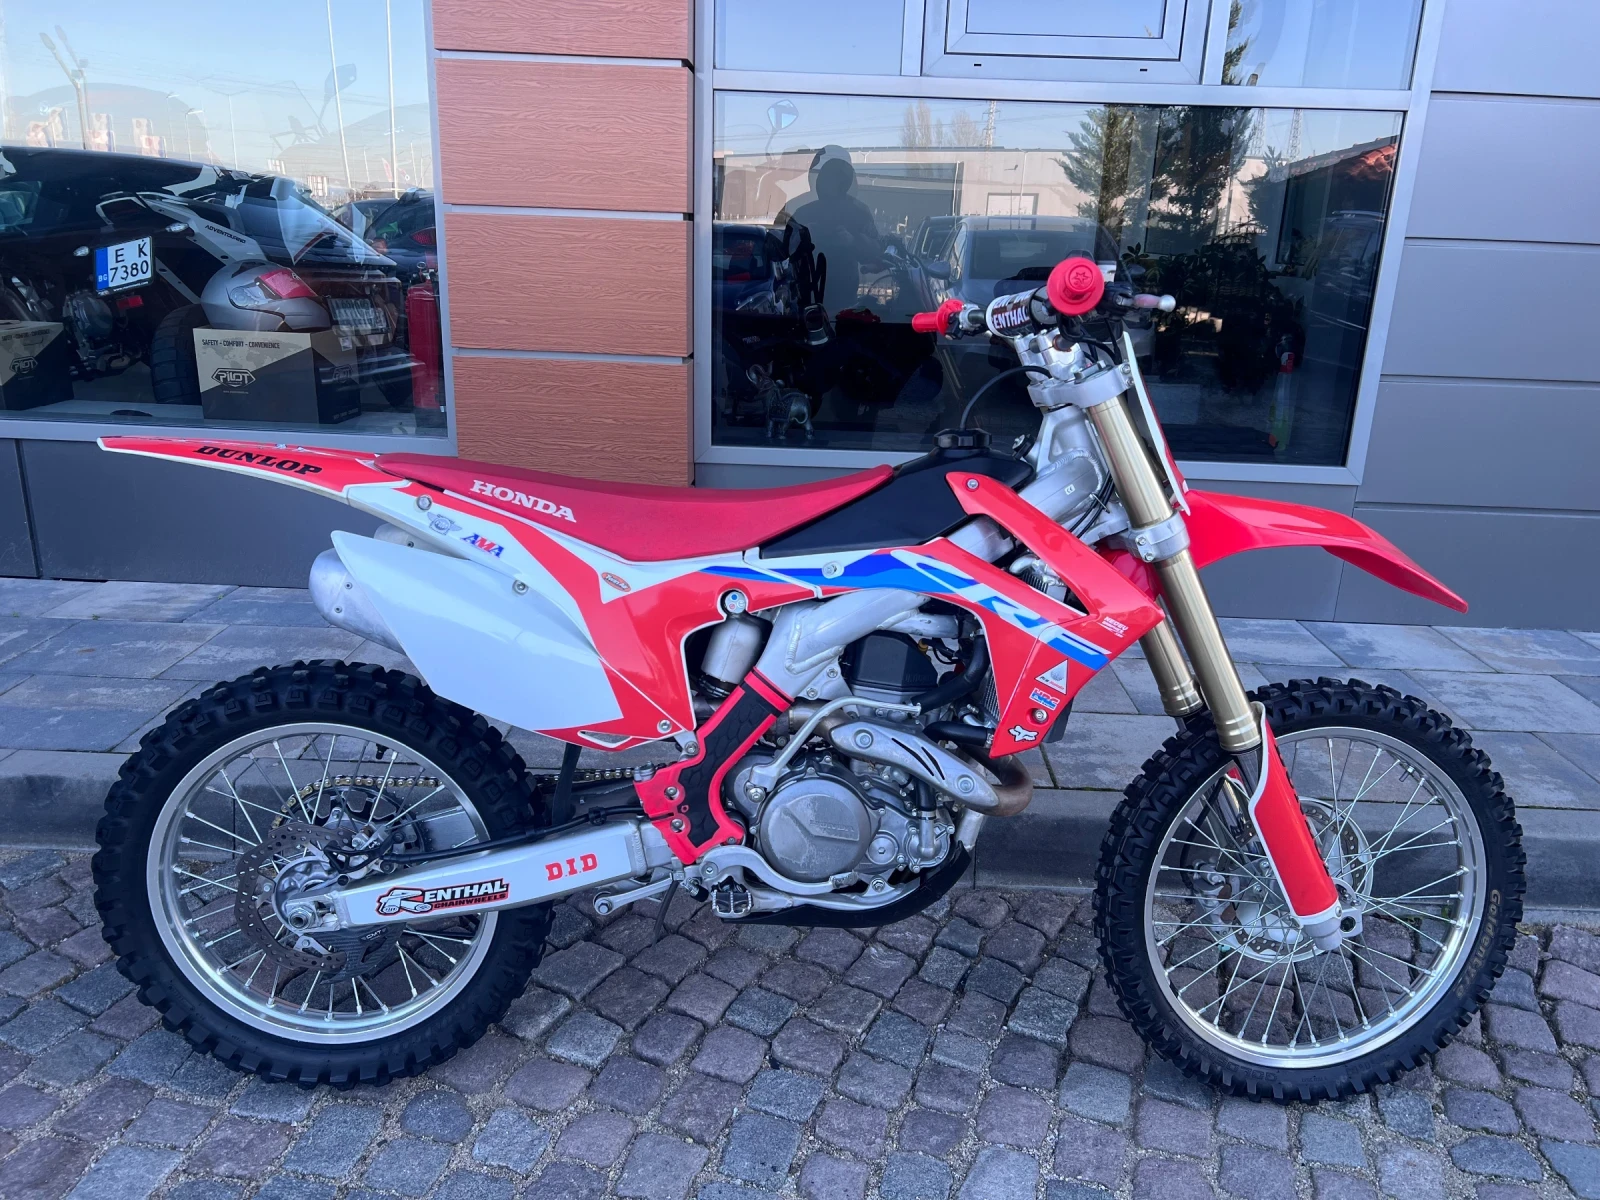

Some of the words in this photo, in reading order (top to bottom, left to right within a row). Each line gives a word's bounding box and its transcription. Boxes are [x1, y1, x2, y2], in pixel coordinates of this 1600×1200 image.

[115, 247, 125, 264] E
[137, 241, 148, 258] K
[98, 273, 108, 282] BG
[109, 259, 149, 283] 7380
[991, 304, 1031, 330] ENTHAL
[248, 341, 280, 349] CONVENIENCE
[193, 445, 323, 475] DUNLOP
[469, 479, 578, 523] HONDA
[461, 533, 504, 558] AMA
[379, 880, 508, 914] RENTHAL
[433, 893, 506, 909] CHAINWHEELS
